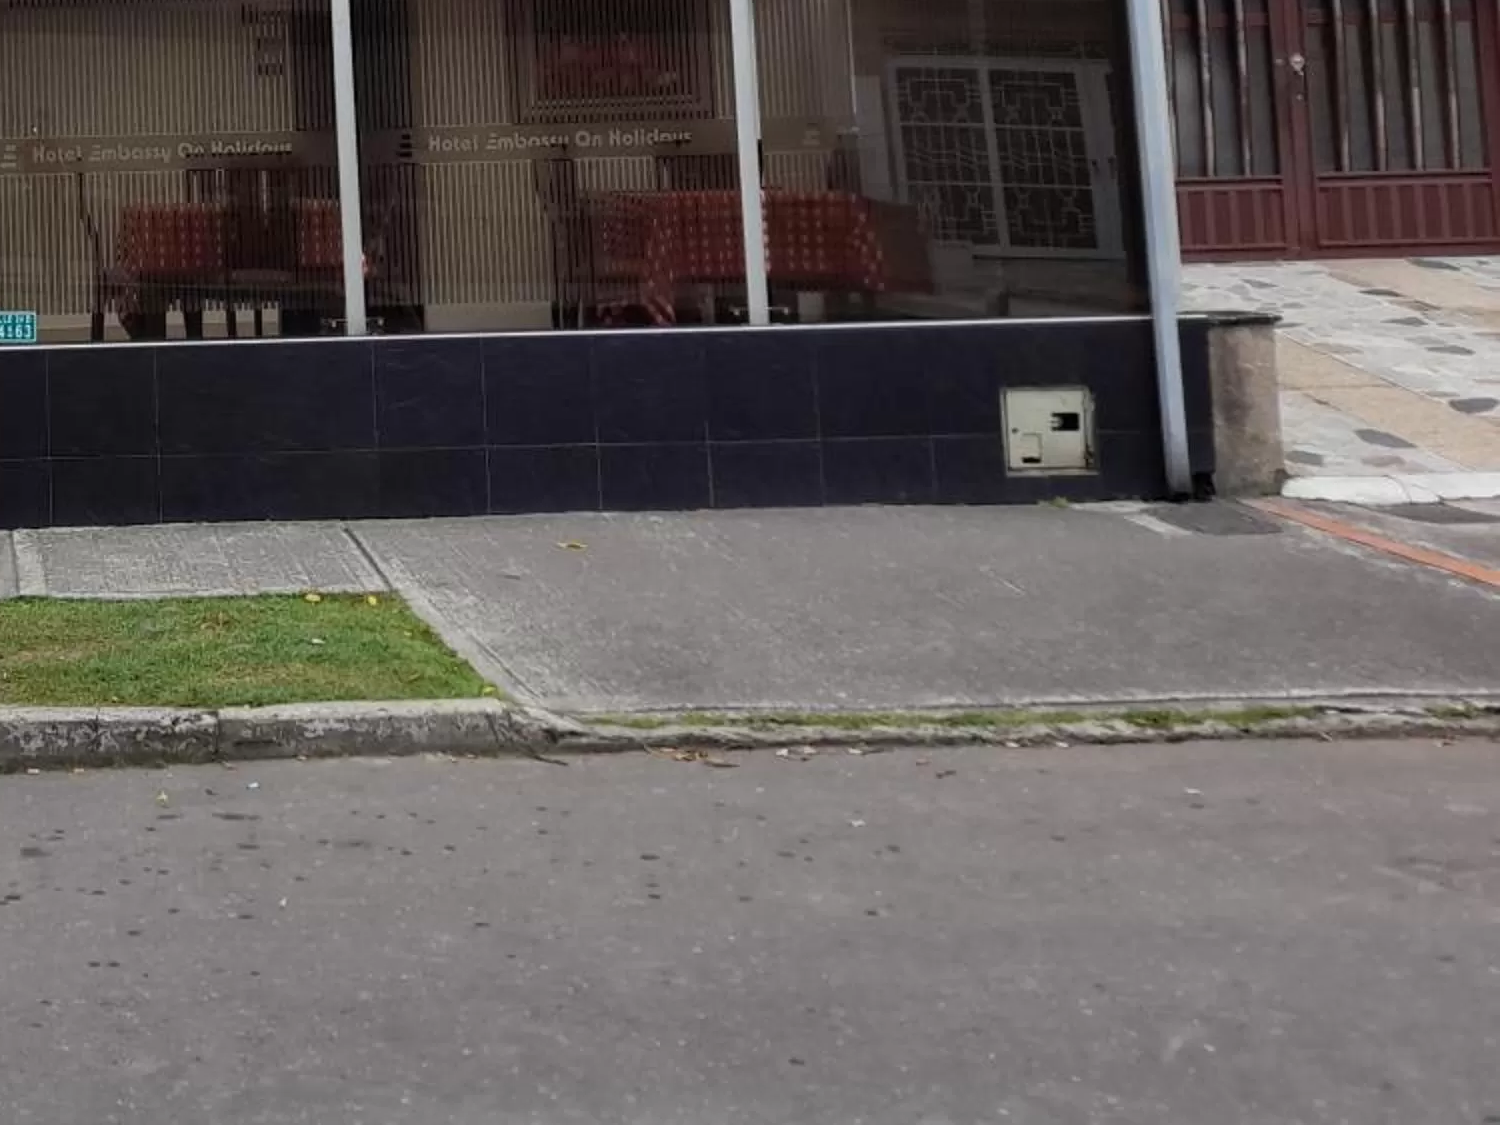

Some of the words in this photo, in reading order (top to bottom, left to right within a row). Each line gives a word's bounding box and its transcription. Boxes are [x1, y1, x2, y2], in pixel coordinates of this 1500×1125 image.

[428, 134, 478, 152] Hotel
[575, 130, 603, 148] On
[32, 144, 84, 165] Hotel
[88, 143, 172, 167] Embassy
[177, 141, 206, 159] On
